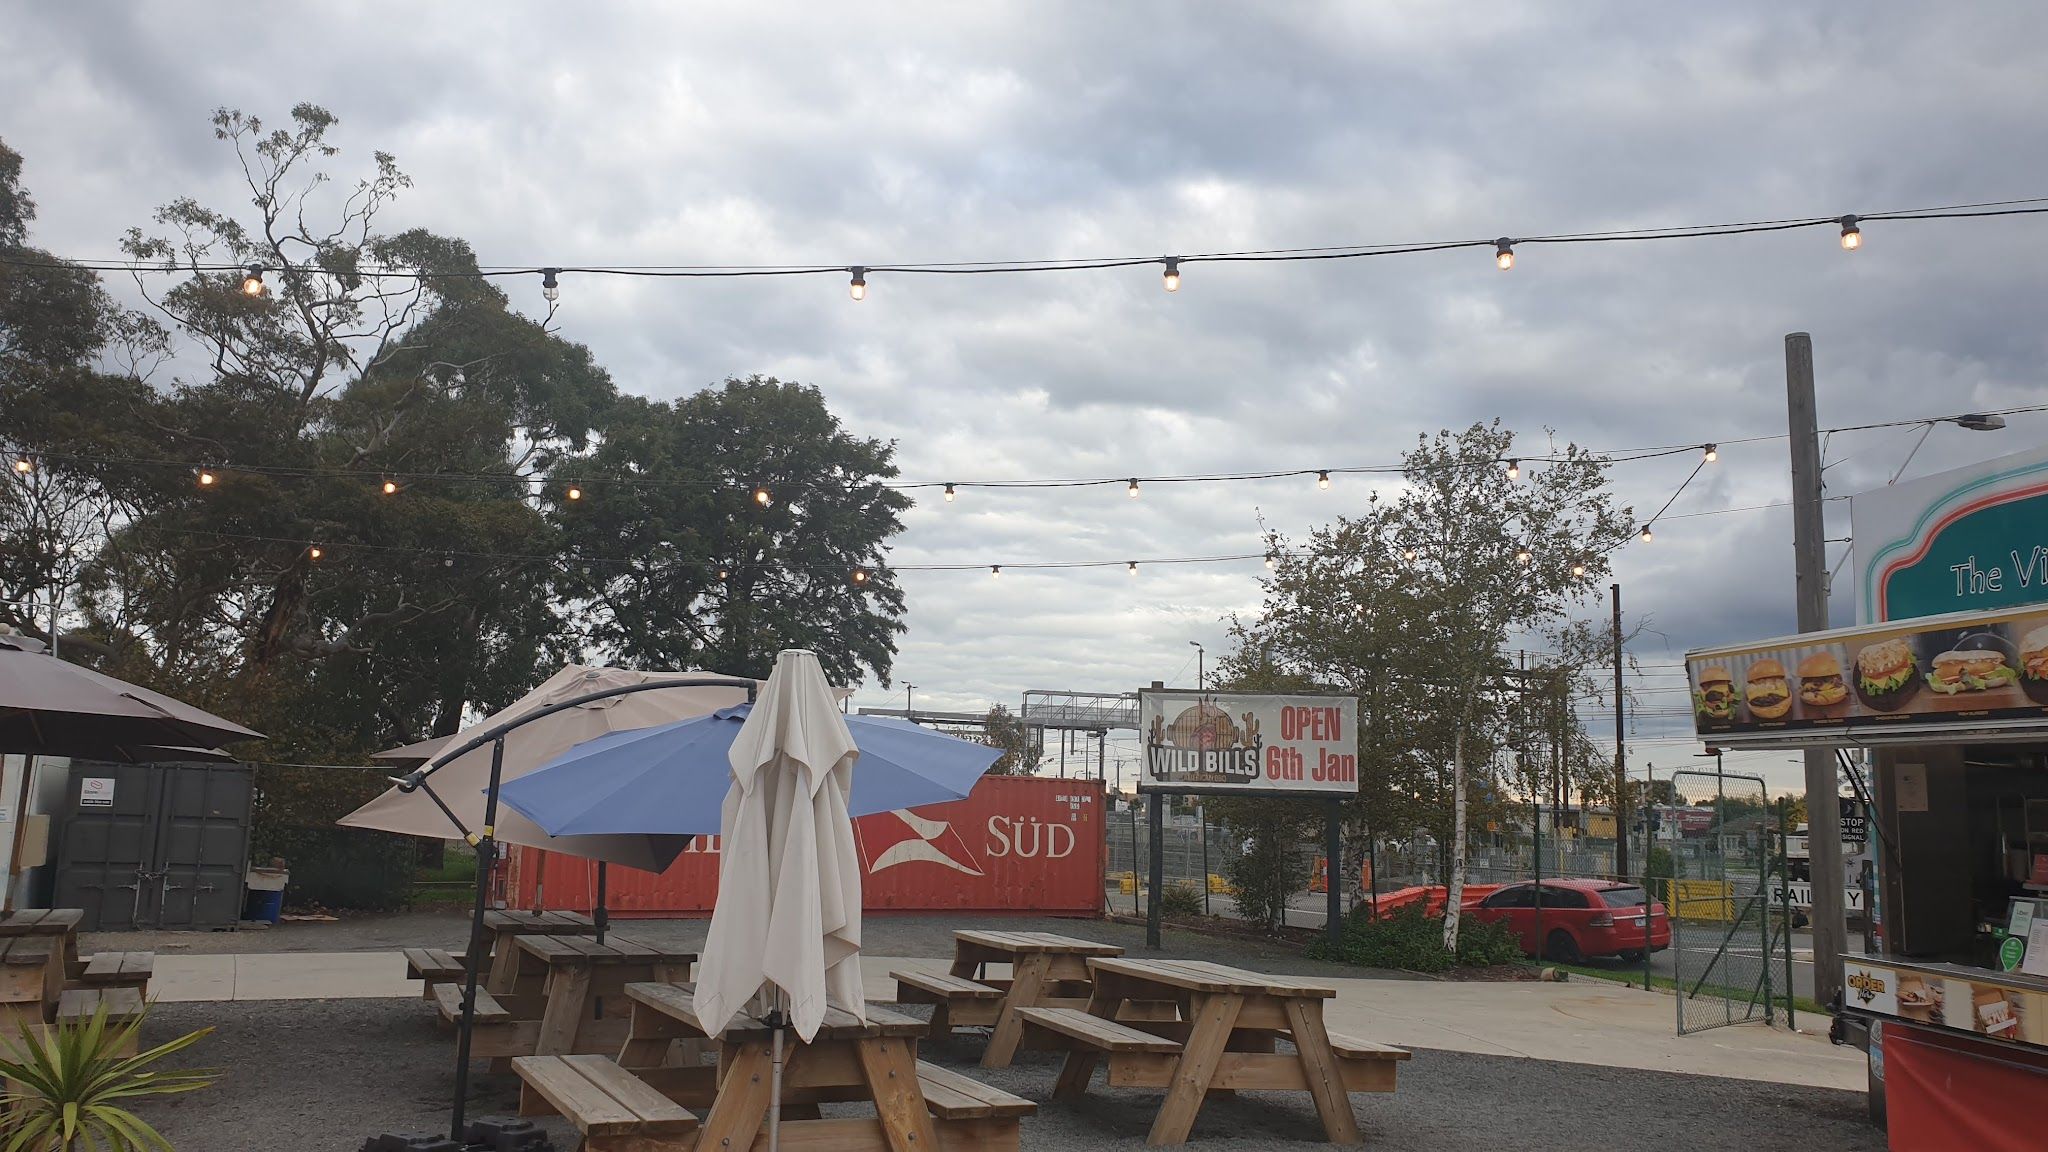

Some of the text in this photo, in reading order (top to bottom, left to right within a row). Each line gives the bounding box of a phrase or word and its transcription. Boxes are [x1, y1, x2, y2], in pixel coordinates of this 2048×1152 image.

[1950, 555, 2002, 596] The
[1281, 706, 1341, 741] OPEN
[1151, 747, 1257, 776] WILD BILLS
[1266, 746, 1355, 782] 6th Jan
[986, 815, 1075, 858] SÜD
[1840, 817, 1864, 827] STOP
[1848, 974, 1885, 993] ORDER
